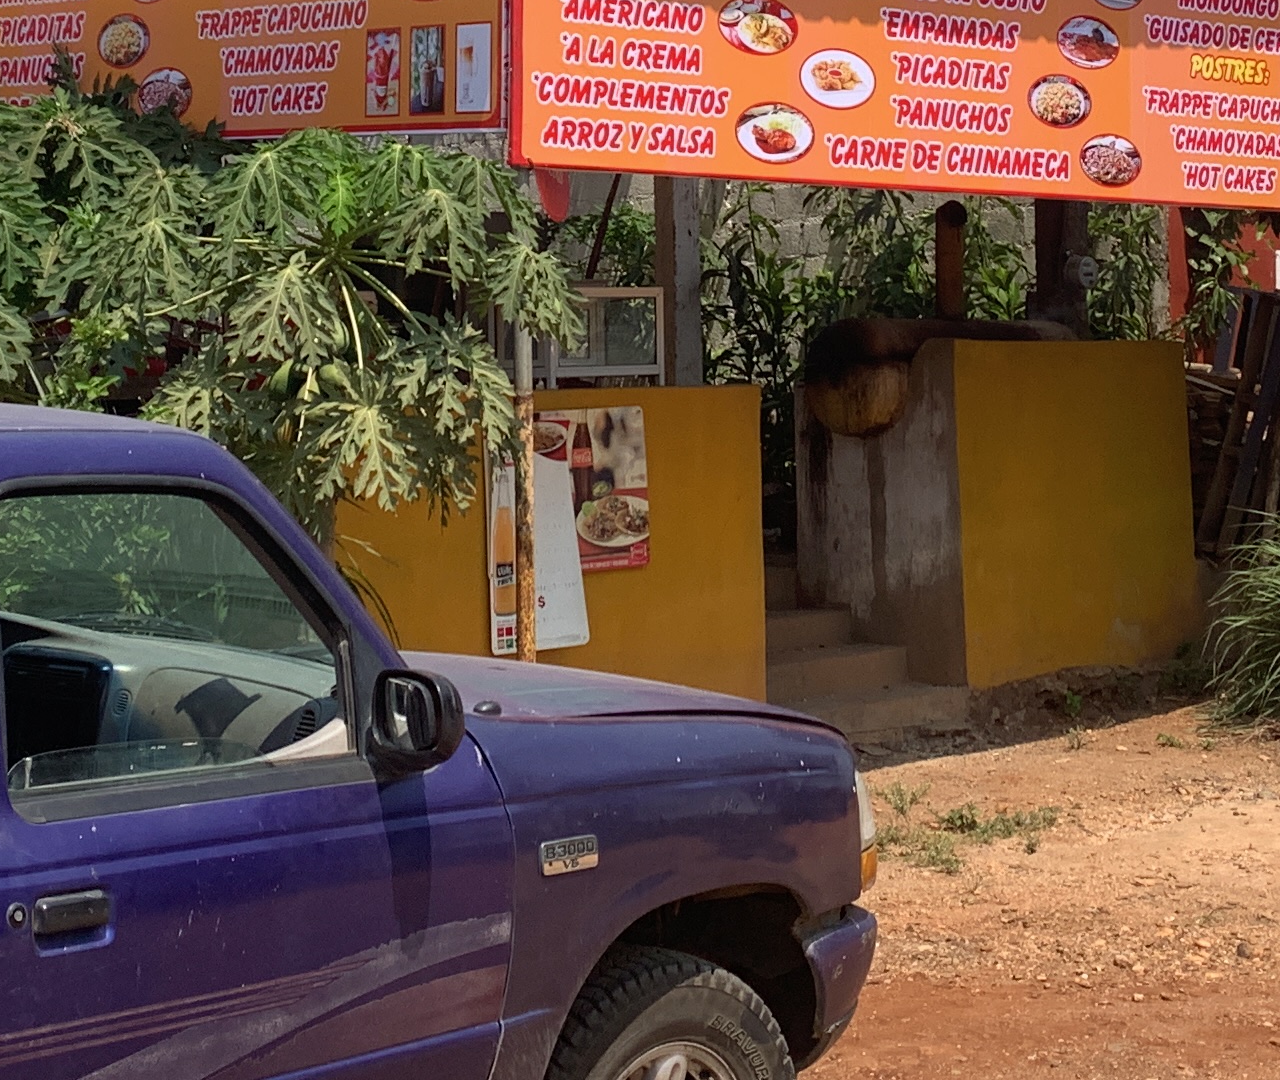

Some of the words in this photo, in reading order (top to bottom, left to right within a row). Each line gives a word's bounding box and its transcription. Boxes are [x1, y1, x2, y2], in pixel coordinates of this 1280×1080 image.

[1, 14, 84, 44] PICADITAS
[200, 8, 262, 38] FRAPPE
[268, 0, 367, 32] CAPUCHINO
[886, 13, 1018, 48] EMPANADAS
[1149, 18, 1222, 46] GUISADO
[1228, 28, 1249, 49] DE
[224, 45, 337, 75] CHAMOYADAS
[566, 37, 579, 61] A
[588, 39, 612, 64] LA
[622, 42, 700, 72] CREMA
[1191, 55, 1270, 84] POSTRES:
[0, 56, 83, 85] PANUCS
[897, 57, 1009, 89] PICADITAS
[233, 89, 267, 113] HOT
[272, 85, 326, 111] CAKES
[539, 77, 728, 114] COMPLEMENTOS
[1148, 90, 1211, 116] FRAPPE
[896, 100, 1010, 132] PANUCHOS
[543, 119, 622, 149] ARROZ
[631, 124, 643, 150] Y
[649, 127, 714, 154] SALSA
[832, 138, 905, 169] CARNE
[912, 144, 940, 170] DE
[947, 147, 1069, 179] CHINAMECA
[1186, 166, 1220, 188] HOT
[1225, 169, 1276, 191] CAKES
[538, 596, 545, 608] $
[545, 841, 595, 860] B3000
